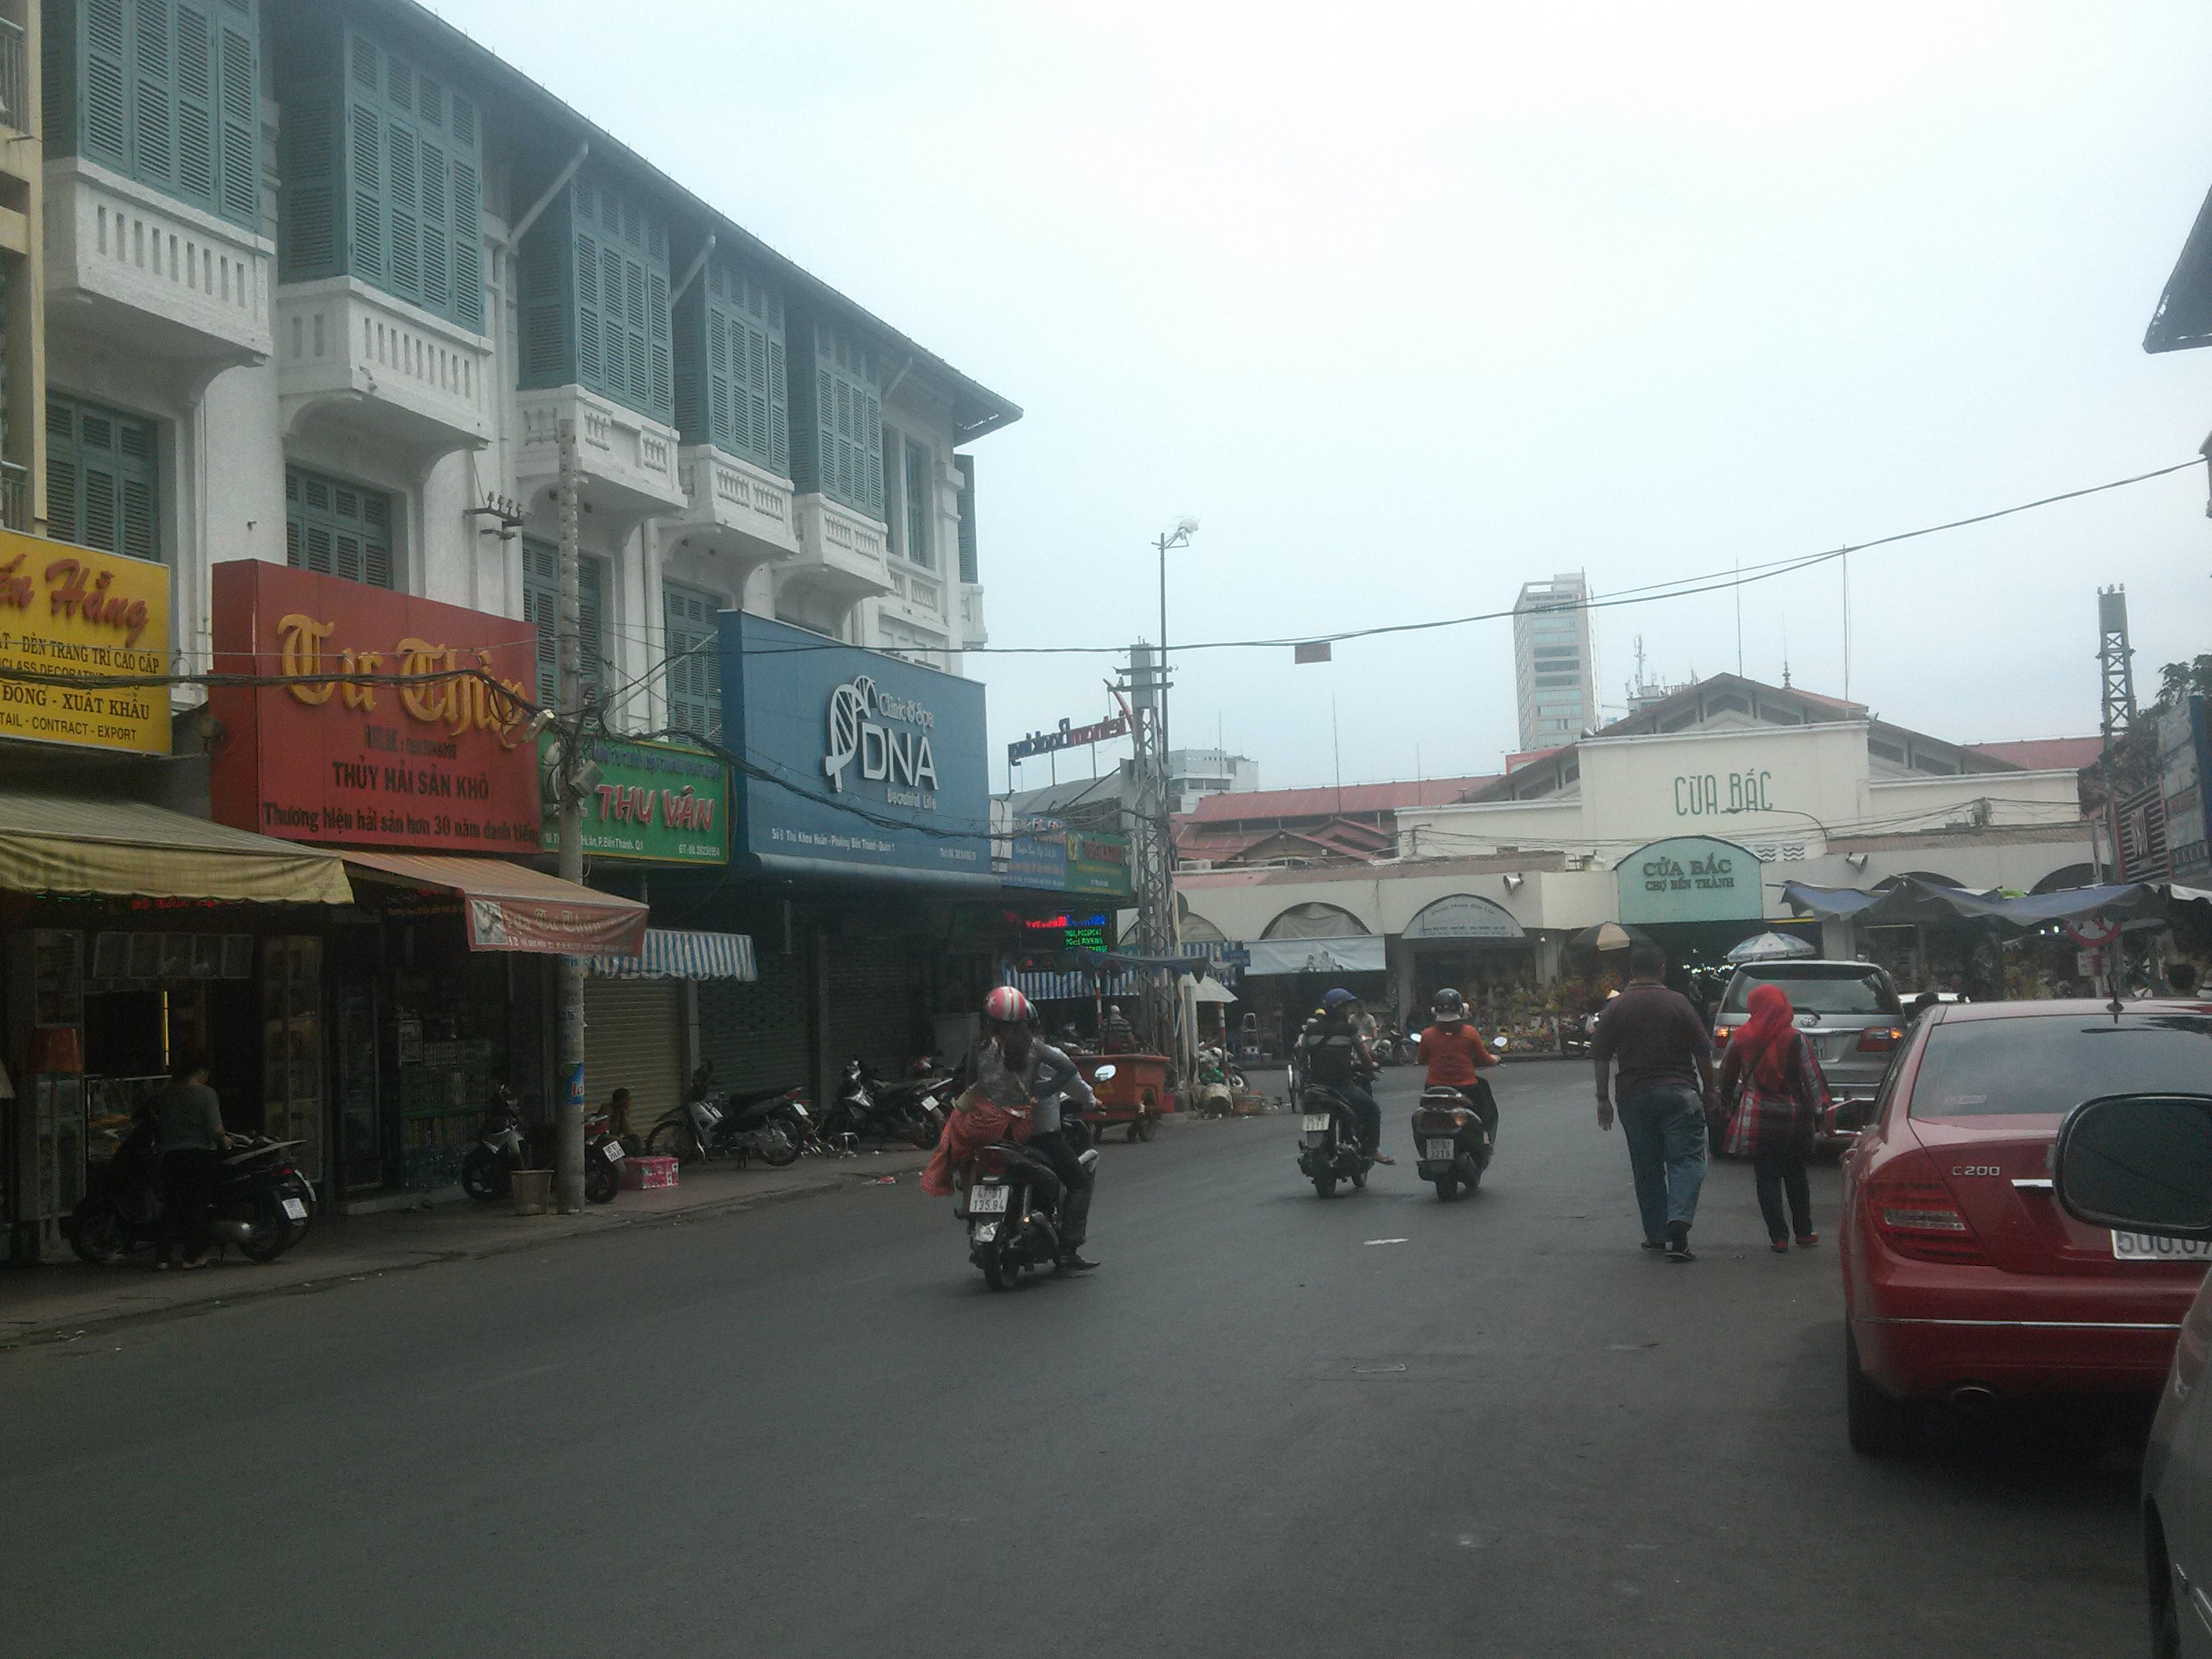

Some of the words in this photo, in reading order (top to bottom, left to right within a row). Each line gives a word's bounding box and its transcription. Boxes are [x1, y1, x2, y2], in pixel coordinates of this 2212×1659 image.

[50, 640, 89, 663] TRANG
[114, 651, 136, 670] CAO
[33, 716, 89, 735] CONTRACT
[98, 724, 136, 741] EXPORT
[862, 722, 939, 790] DNA
[596, 784, 656, 825] THU
[434, 815, 451, 836] 30
[1689, 852, 1732, 876] BẮC
